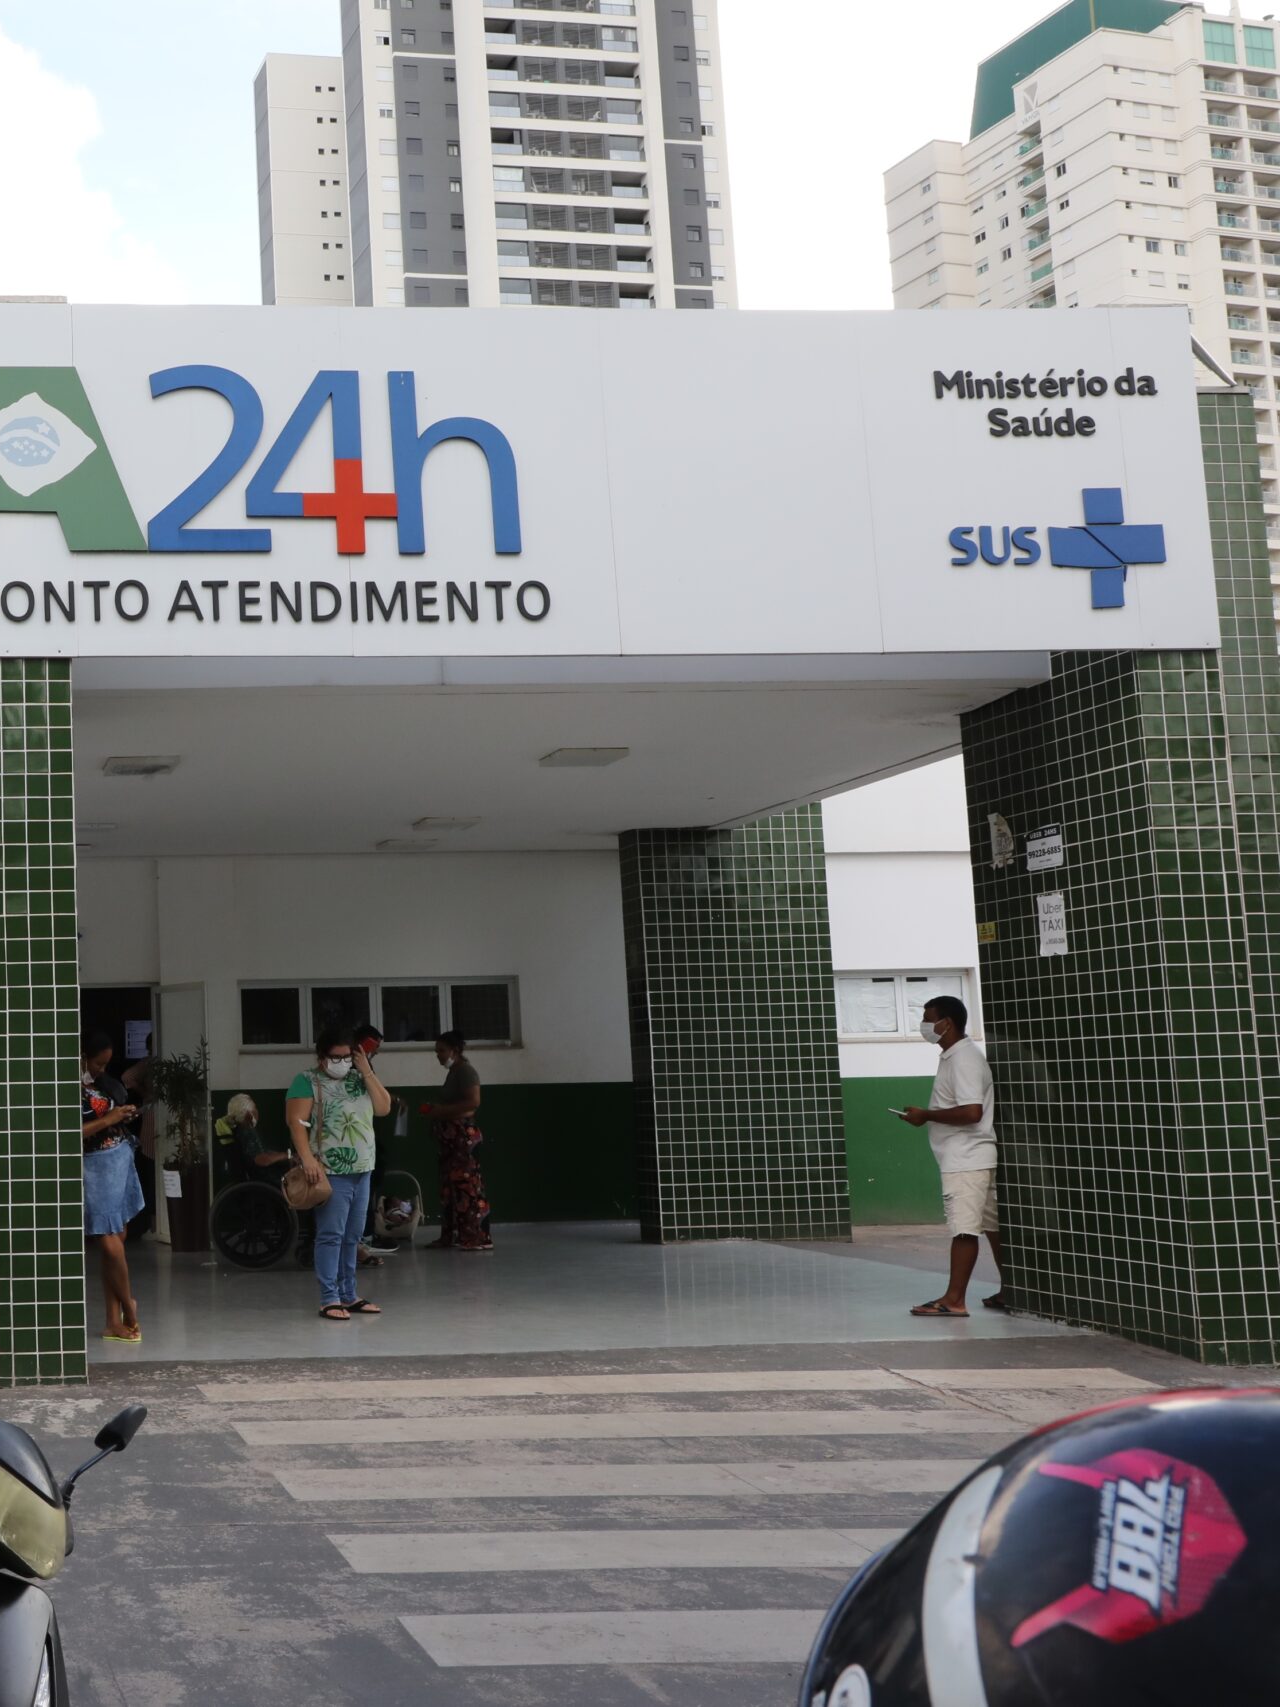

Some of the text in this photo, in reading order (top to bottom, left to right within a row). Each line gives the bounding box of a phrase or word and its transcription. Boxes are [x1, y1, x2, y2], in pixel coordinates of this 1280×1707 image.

[933, 366, 1158, 400] Ministério da
[987, 407, 1096, 437] Saúde
[949, 526, 1041, 567] SUS
[167, 578, 552, 623] ATENDIMENTO
[1042, 902, 1063, 915] Uber
[1109, 1473, 1170, 1610] 788
